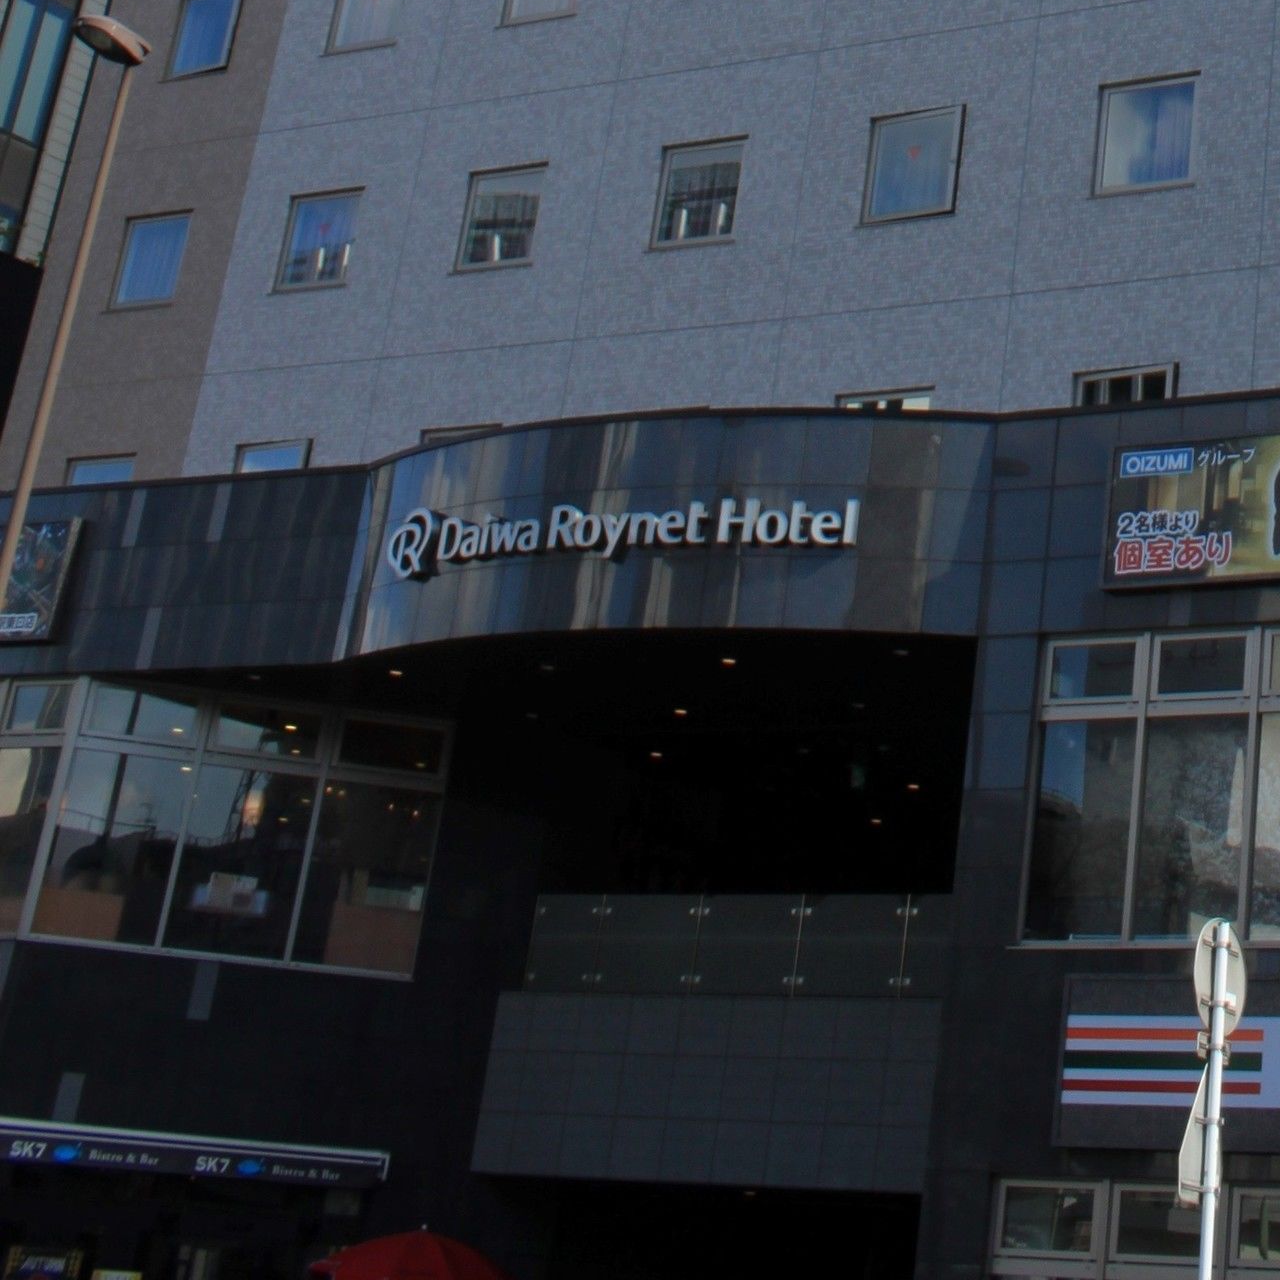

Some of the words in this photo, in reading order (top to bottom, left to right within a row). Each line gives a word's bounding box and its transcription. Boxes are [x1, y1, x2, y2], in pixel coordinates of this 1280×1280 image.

[1126, 453, 1189, 474] OIZUMI
[437, 513, 538, 561] Daiwa
[547, 499, 708, 559] Roynet
[717, 497, 860, 546] Hotel
[1117, 510, 1199, 538] 2名様より
[1114, 531, 1232, 574] 個室あり
[9, 1141, 47, 1159] SK7
[88, 1148, 123, 1164] Bistro
[140, 1154, 160, 1167] Bar
[195, 1156, 231, 1174] SK7
